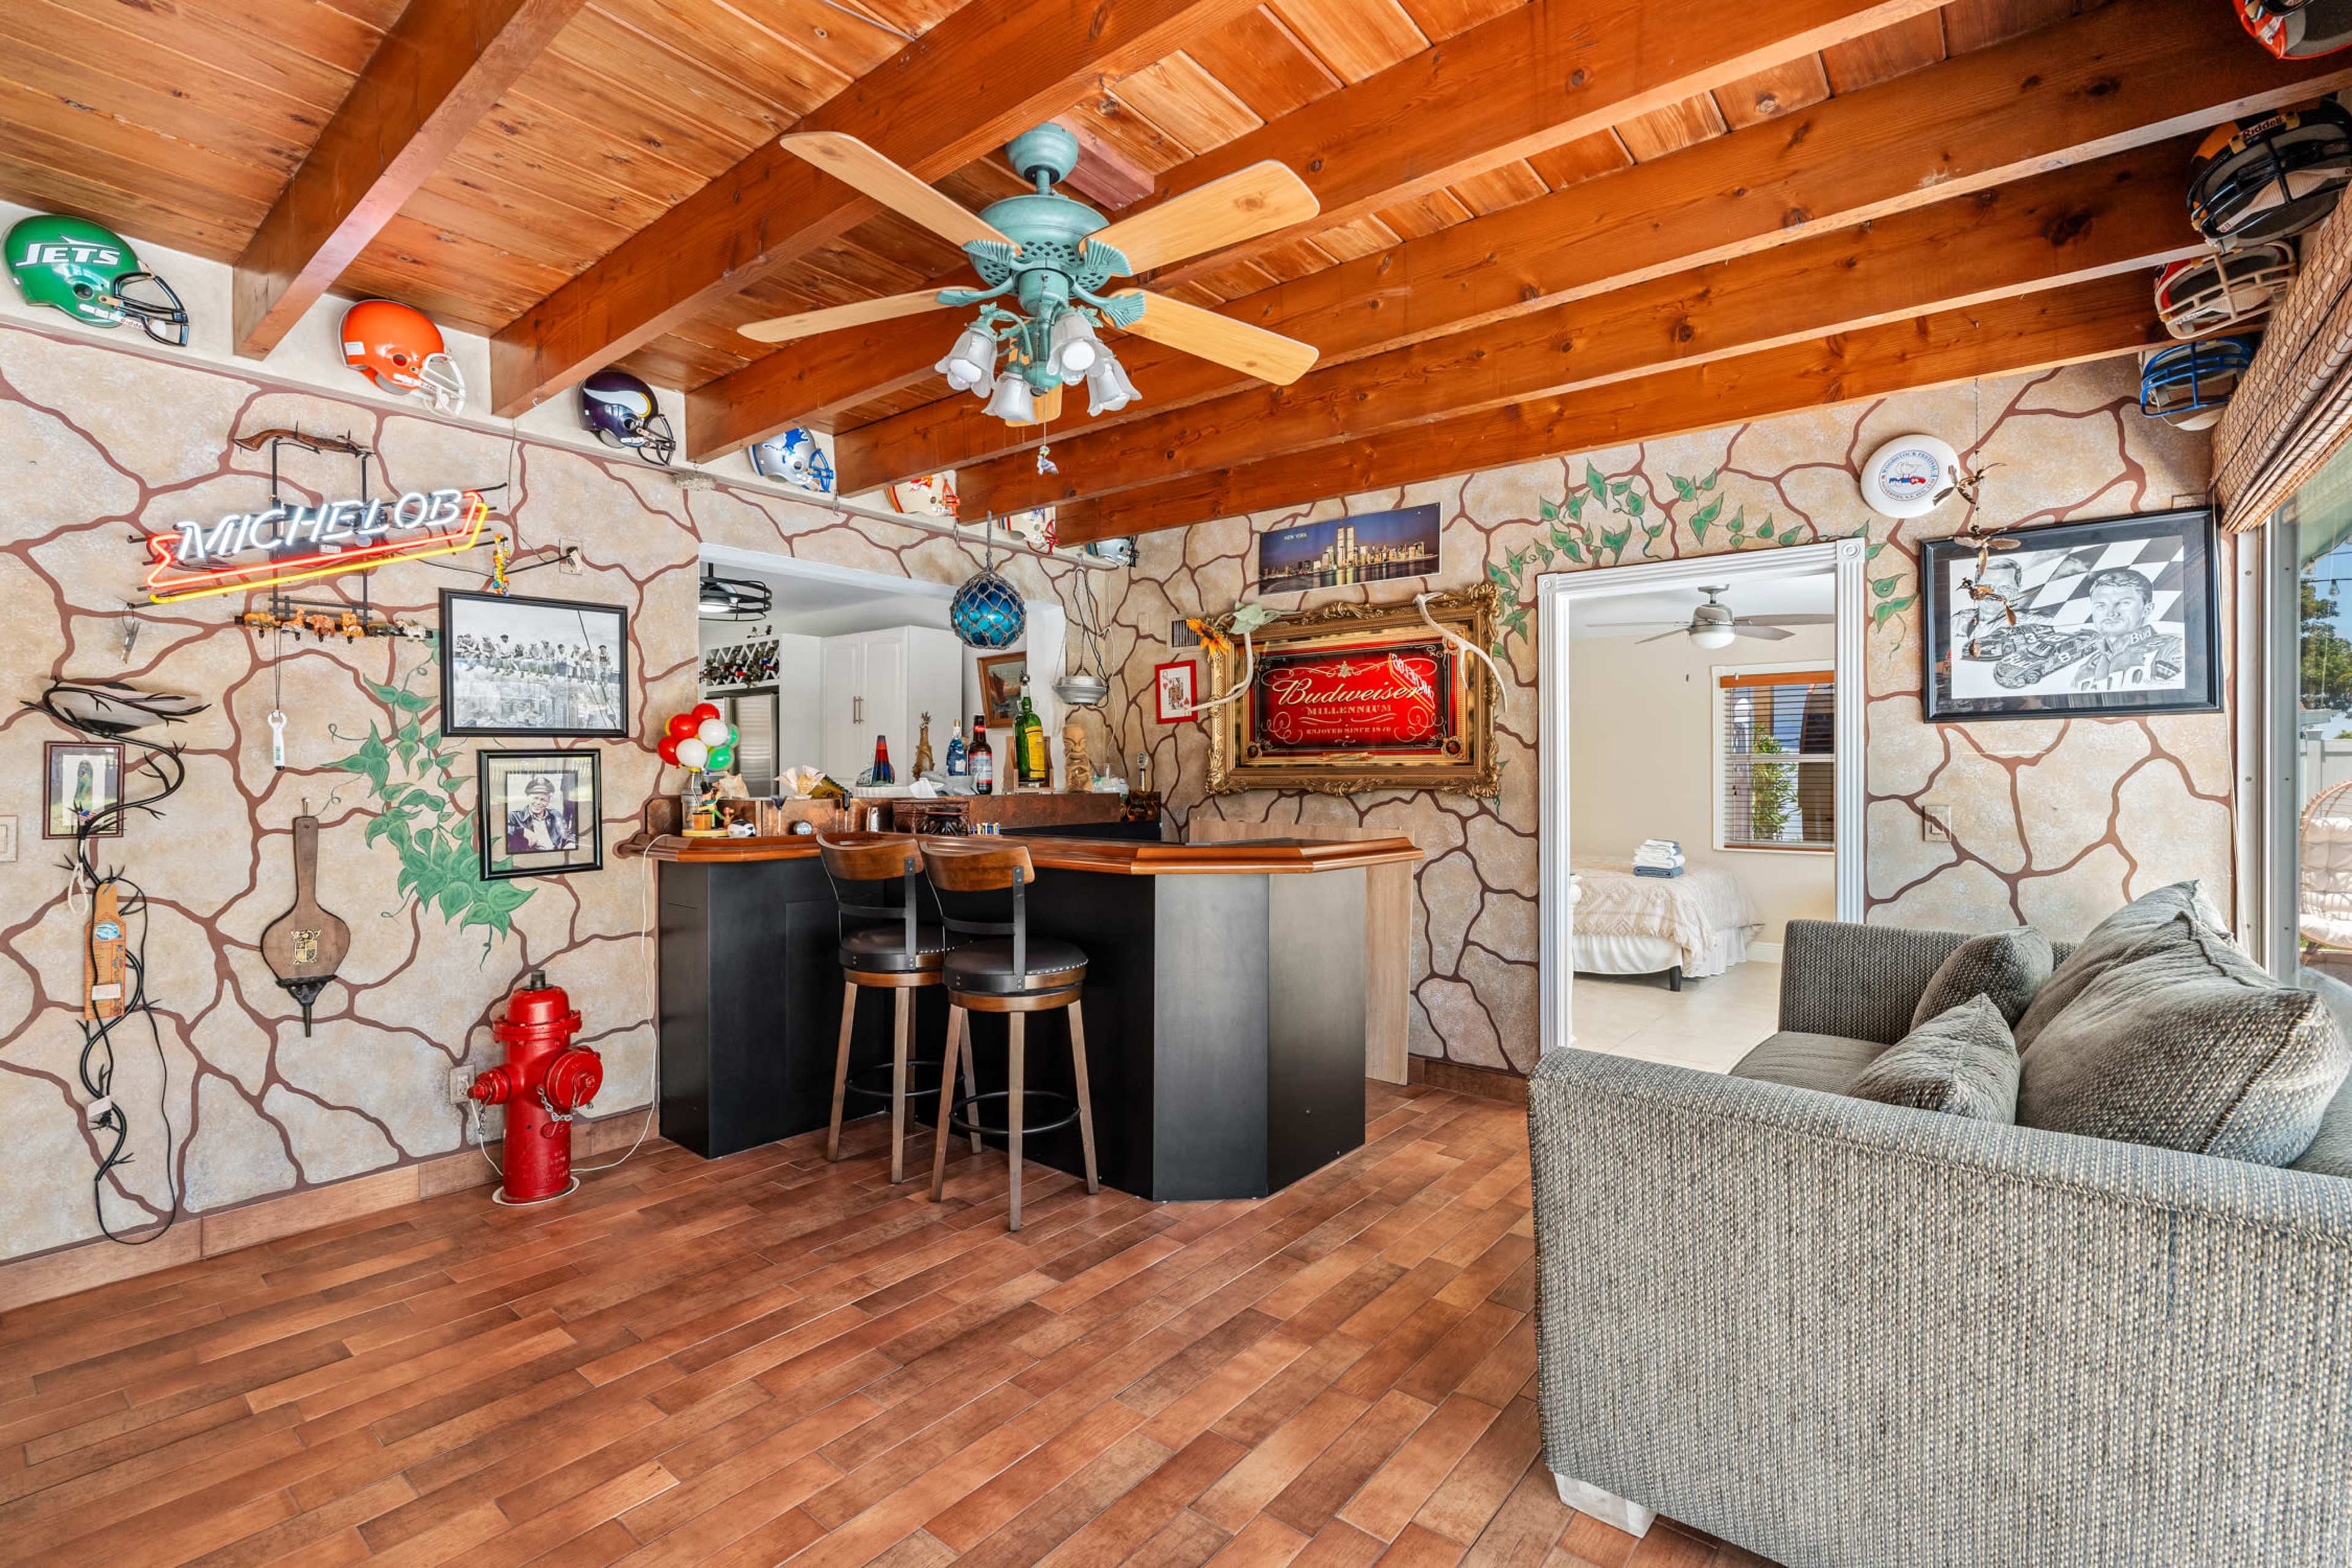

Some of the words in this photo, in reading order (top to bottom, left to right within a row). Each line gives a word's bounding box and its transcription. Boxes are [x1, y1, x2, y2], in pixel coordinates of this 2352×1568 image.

[2243, 116, 2283, 138] Riddell
[15, 242, 121, 267] JETS
[176, 488, 463, 560] MICHELOB
[2024, 633, 2037, 644] 3
[2130, 626, 2152, 645] Bud
[2000, 653, 2033, 668] Bud
[2059, 652, 2071, 663] 8
[1272, 677, 1422, 706] Budweiser
[1306, 704, 1391, 715] MILLENNIUM
